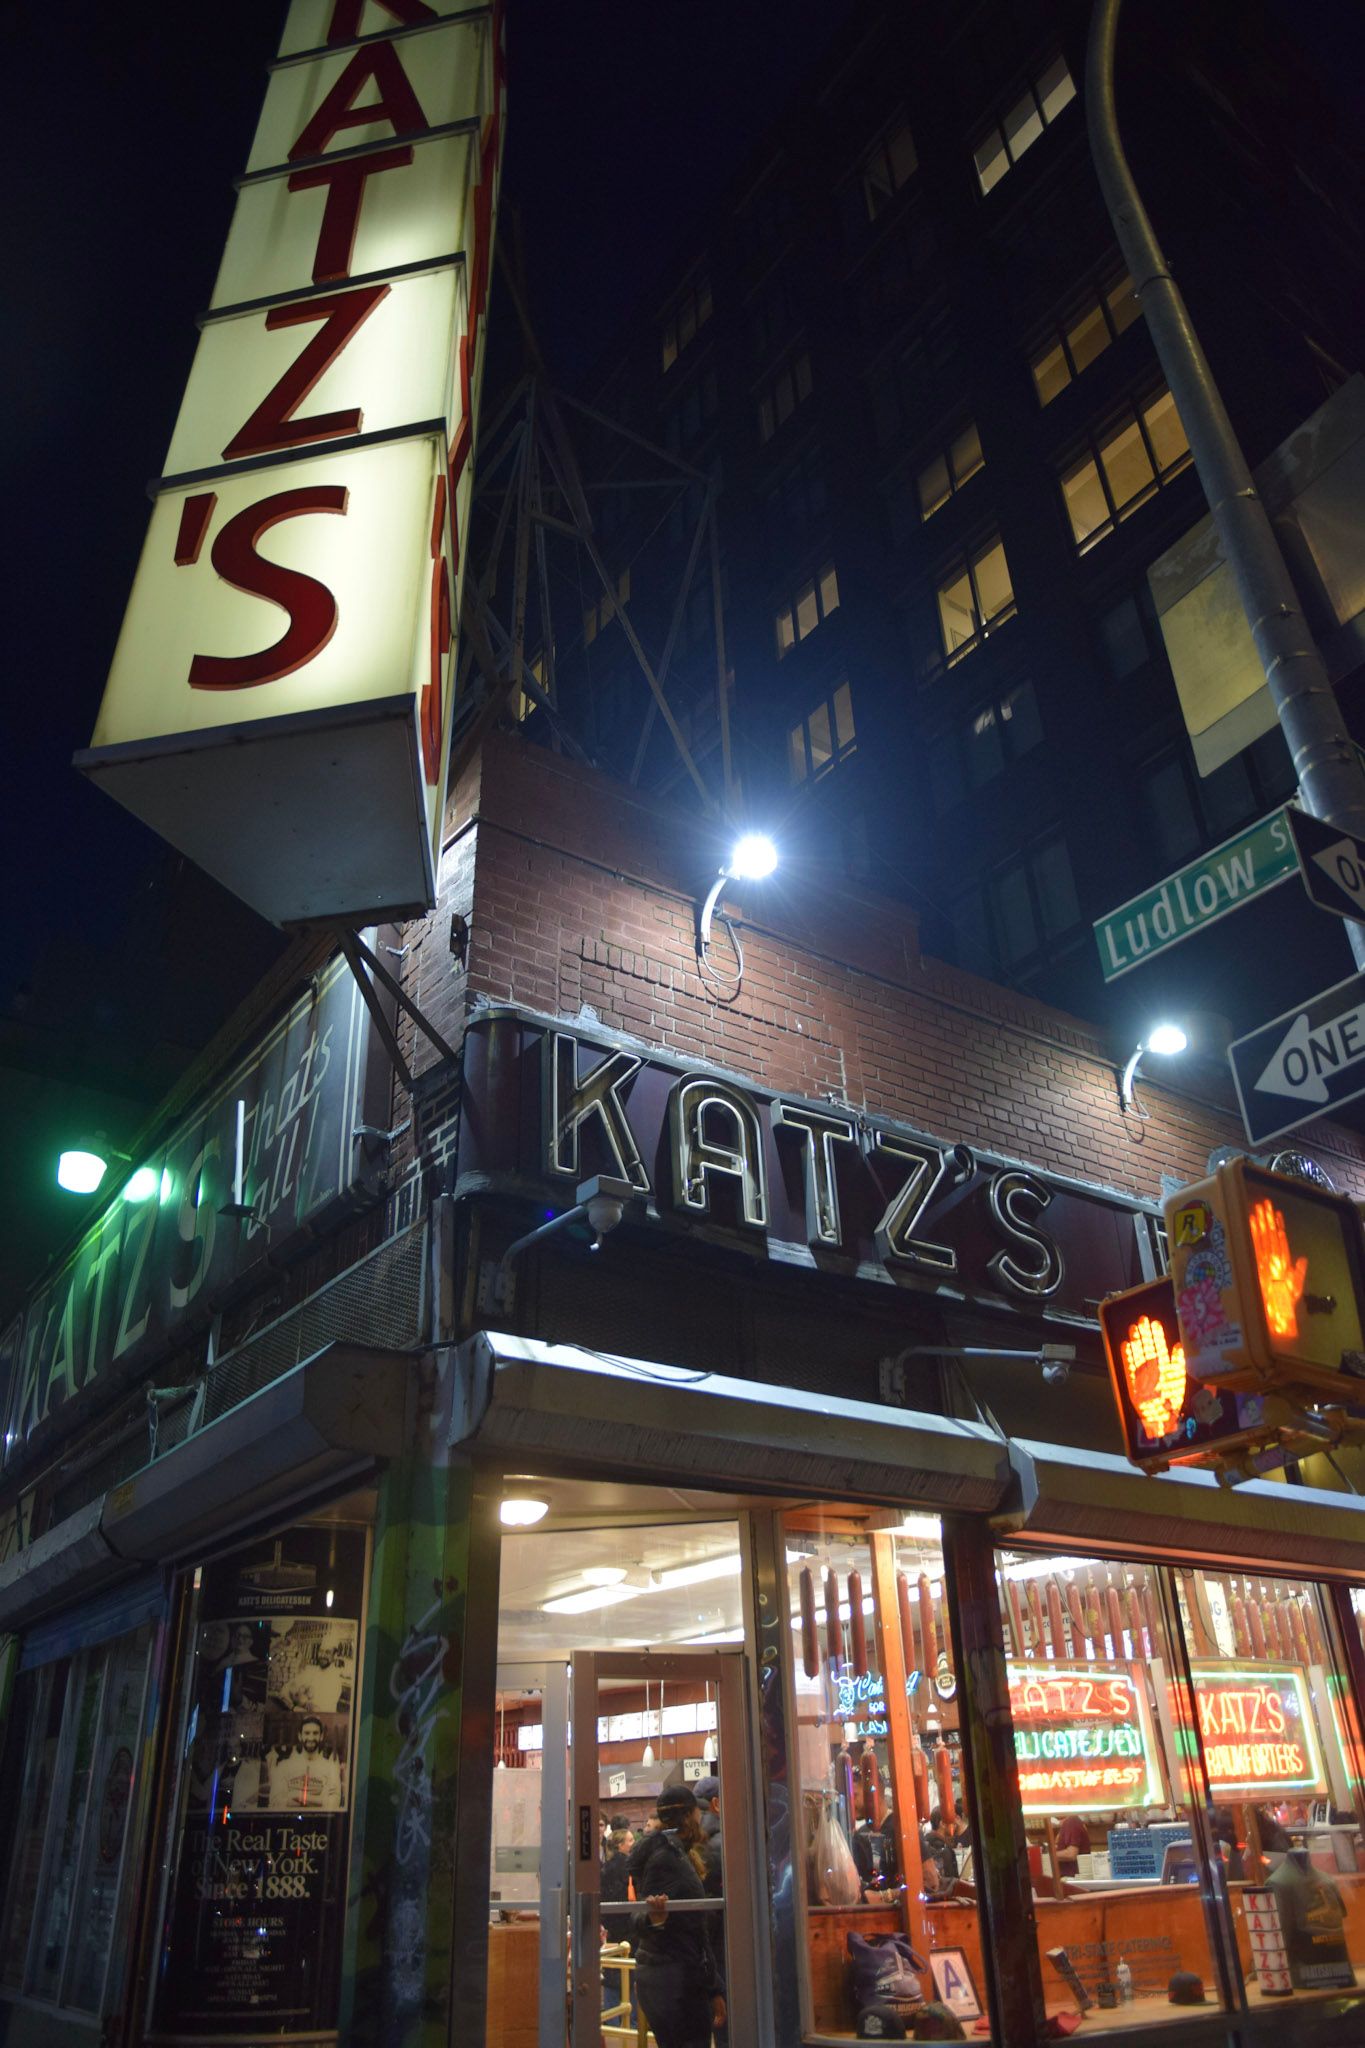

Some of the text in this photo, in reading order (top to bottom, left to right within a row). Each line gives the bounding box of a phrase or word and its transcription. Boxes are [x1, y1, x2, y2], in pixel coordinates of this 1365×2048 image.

[1104, 847, 1256, 969] Ludlow
[1283, 1014, 1365, 1087] ONE
[543, 1030, 1066, 1297] KATZ'S
[261, 1596, 311, 1606] DELICATESSEN
[1198, 1686, 1285, 1737] KATZ'S
[1014, 1724, 1142, 1760] ELICATESSEN
[694, 1769, 700, 1777] 6
[1204, 1743, 1304, 1778] RANKFURTERS
[190, 1828, 329, 1852] The Real Taste
[191, 1851, 319, 1876] of New York.
[195, 1876, 311, 1900] Since 1888.
[248, 1916, 285, 1927] HOURS
[944, 1959, 970, 2000] A
